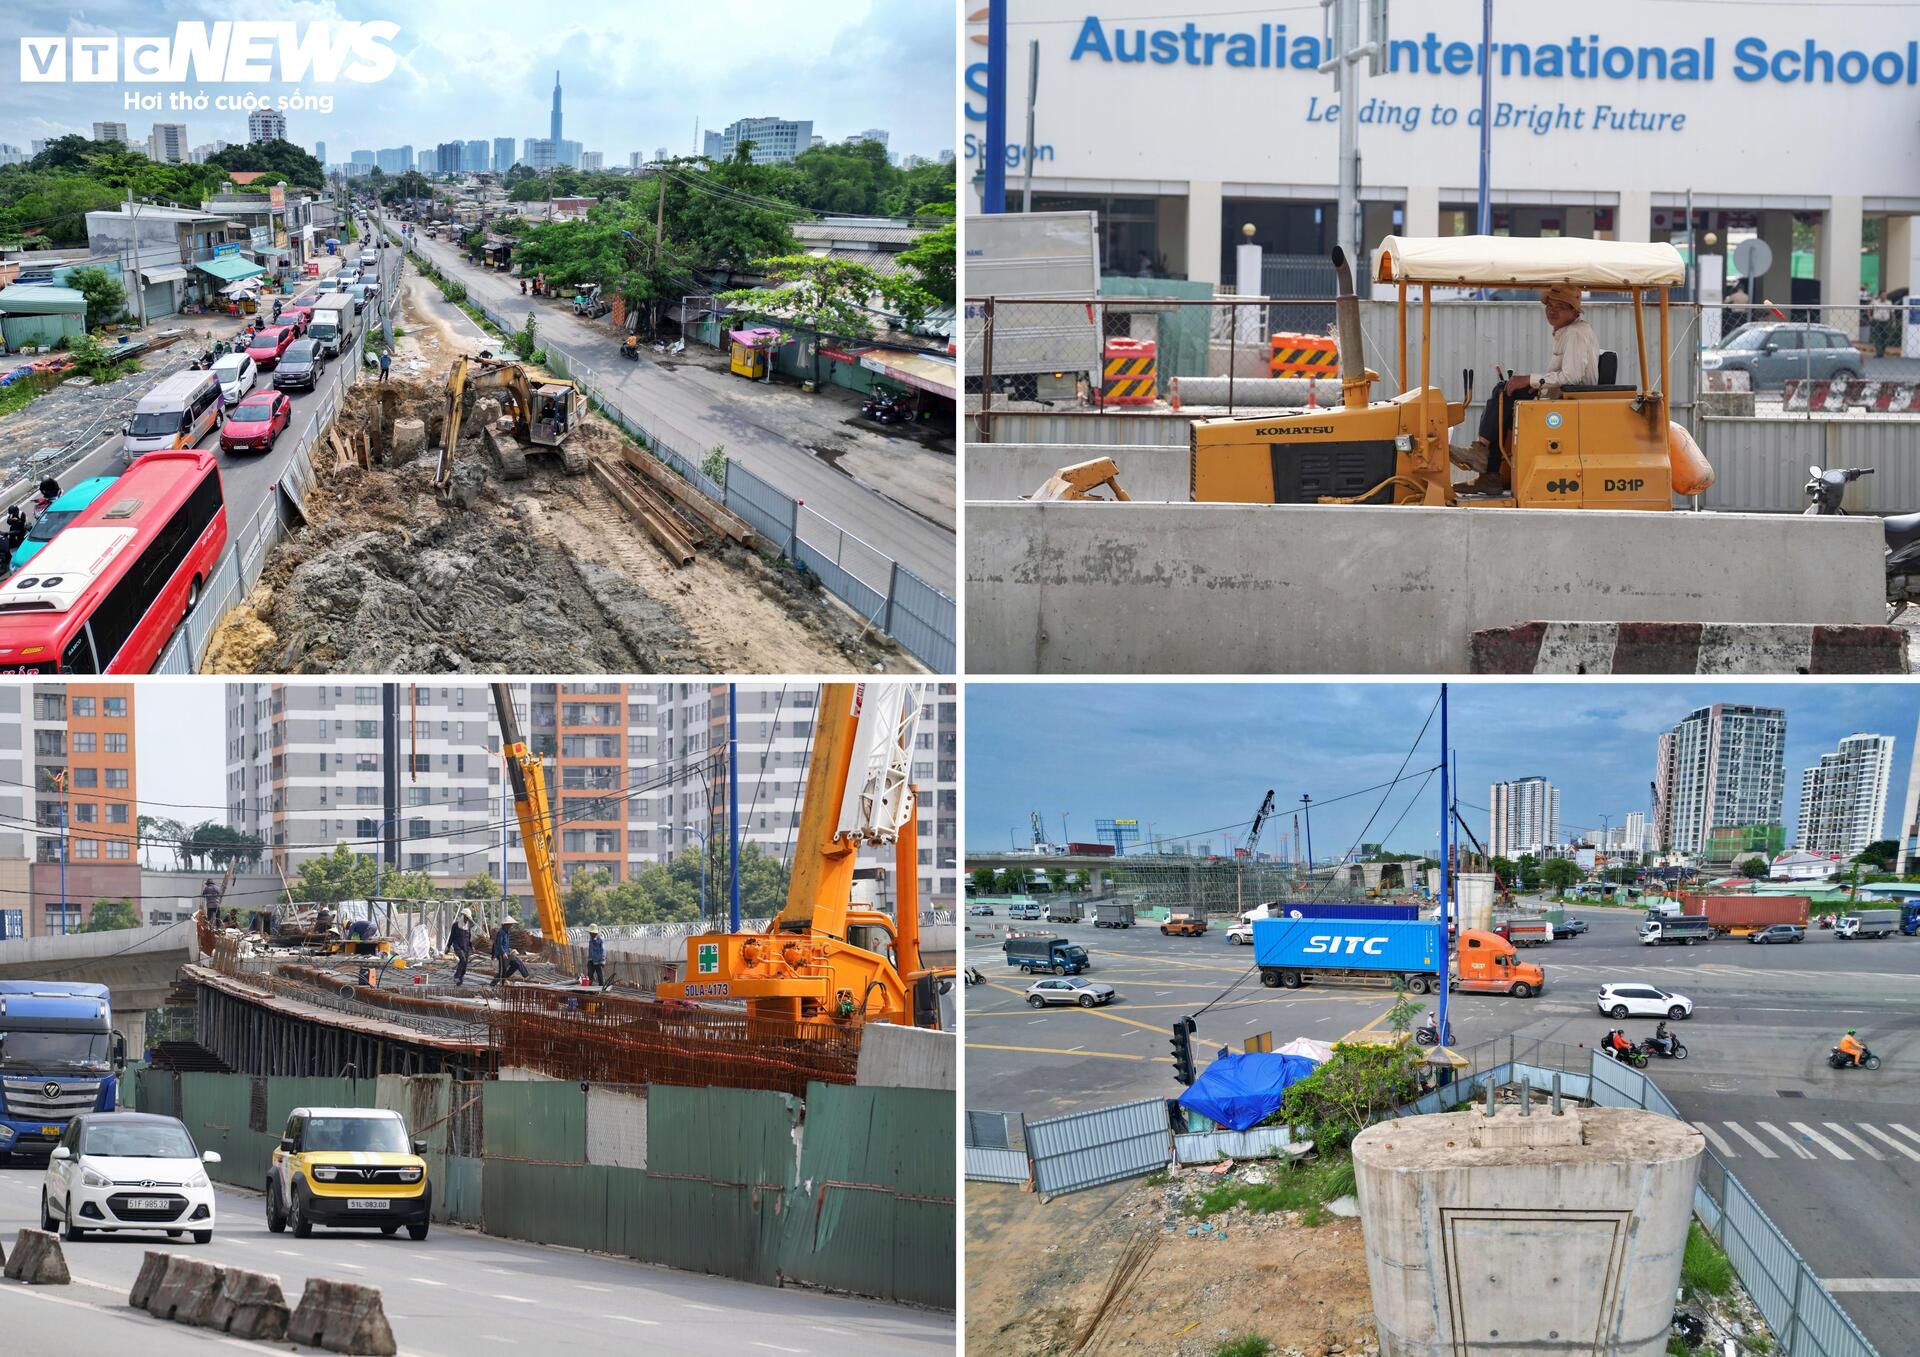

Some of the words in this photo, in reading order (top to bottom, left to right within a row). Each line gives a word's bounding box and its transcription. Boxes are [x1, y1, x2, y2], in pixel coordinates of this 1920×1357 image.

[1070, 16, 1334, 70] Australia
[1388, 32, 1715, 82] nternational
[1734, 37, 1919, 85] School
[1306, 97, 1421, 132] Leding
[1431, 104, 1458, 126] to
[1494, 103, 1584, 135] Bright
[1592, 105, 1687, 131] Future
[965, 134, 1055, 168] Sgon
[1255, 426, 1335, 436] KOMATSU
[1604, 479, 1645, 492] D31P
[1302, 935, 1390, 955] SITC
